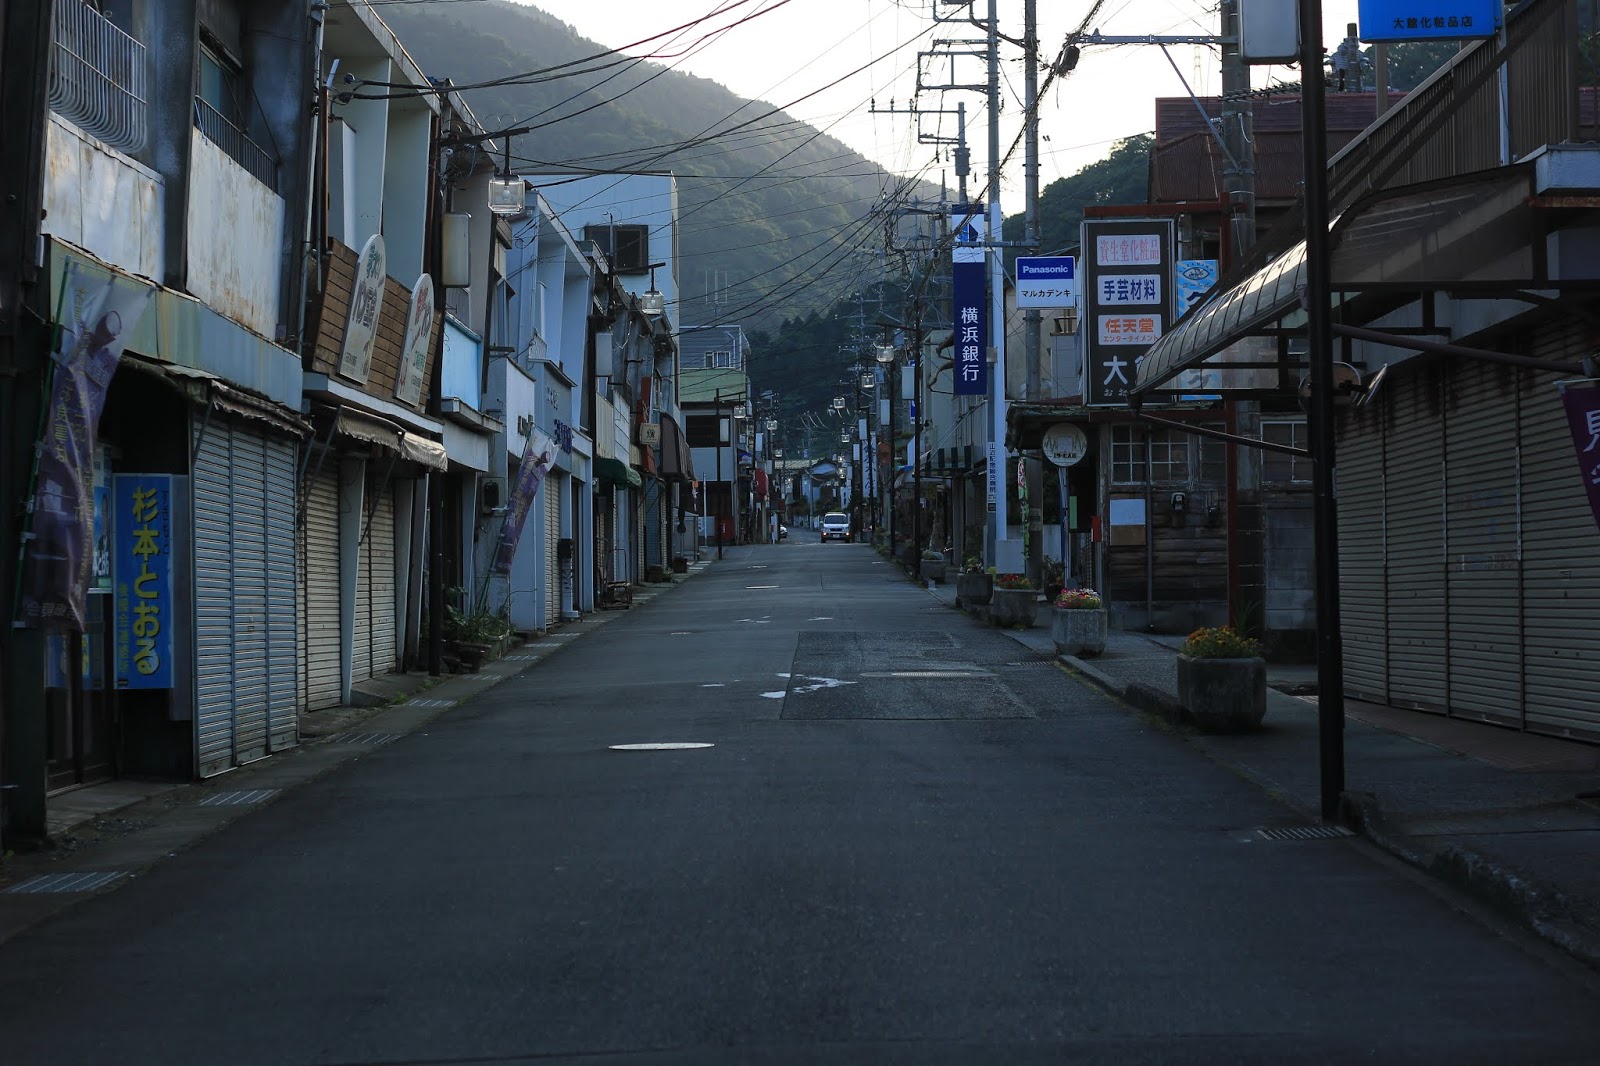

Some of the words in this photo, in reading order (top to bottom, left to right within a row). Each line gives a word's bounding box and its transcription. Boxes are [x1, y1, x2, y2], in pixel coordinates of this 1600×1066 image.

[1100, 239, 1160, 263] 資生堂化粧品
[1022, 264, 1069, 274] Panasonic
[1021, 289, 1071, 298] マルカデンキ
[1103, 279, 1156, 301] 手芸材料
[1105, 318, 1154, 334] 任天堂
[961, 307, 980, 382] 横浜銀行
[132, 485, 160, 675] 杉本とおる
